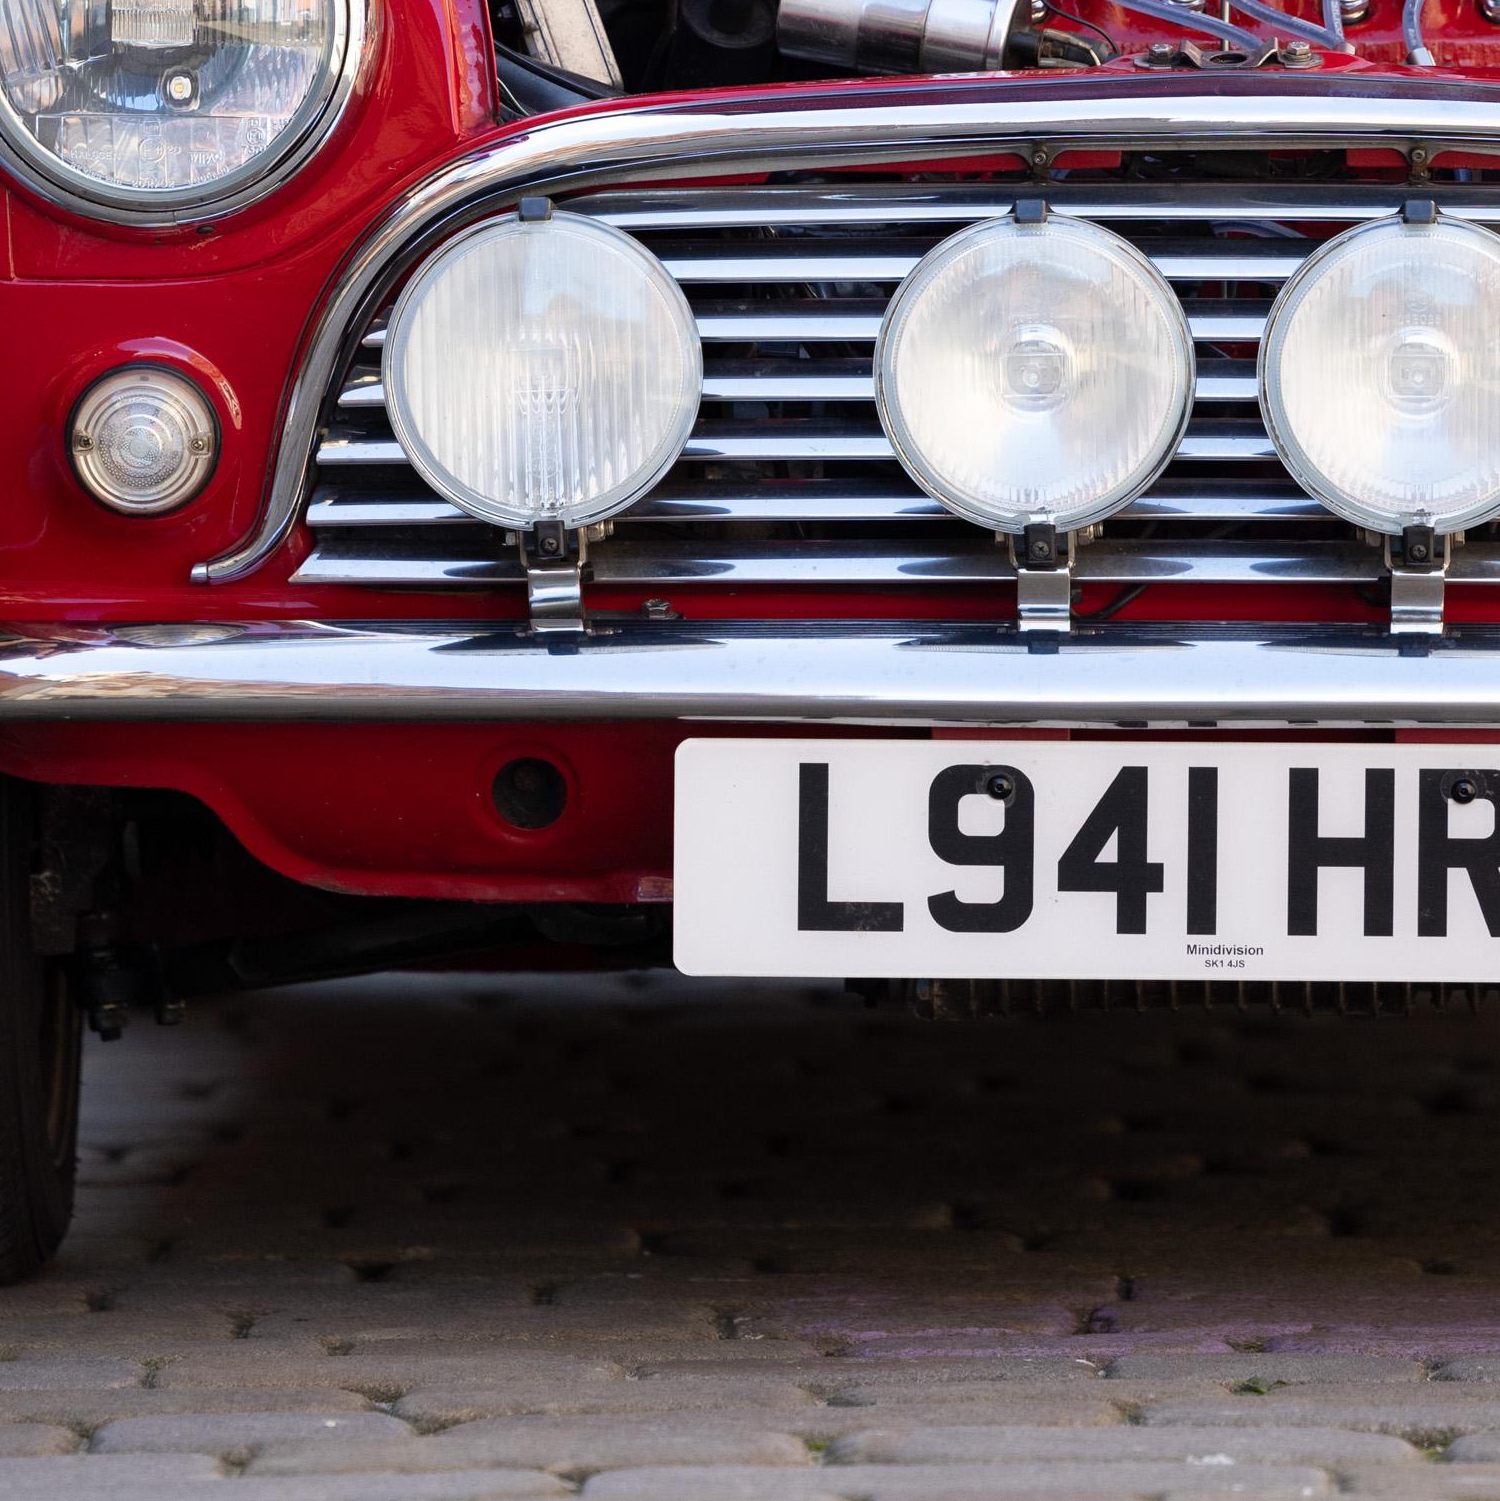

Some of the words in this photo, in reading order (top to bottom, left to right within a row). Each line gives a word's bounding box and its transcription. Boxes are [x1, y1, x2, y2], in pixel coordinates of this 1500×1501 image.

[798, 763, 1218, 935] L941
[1186, 944, 1264, 956] Minidivision
[1204, 959, 1225, 969] SK1
[1227, 959, 1246, 969] 4JS
